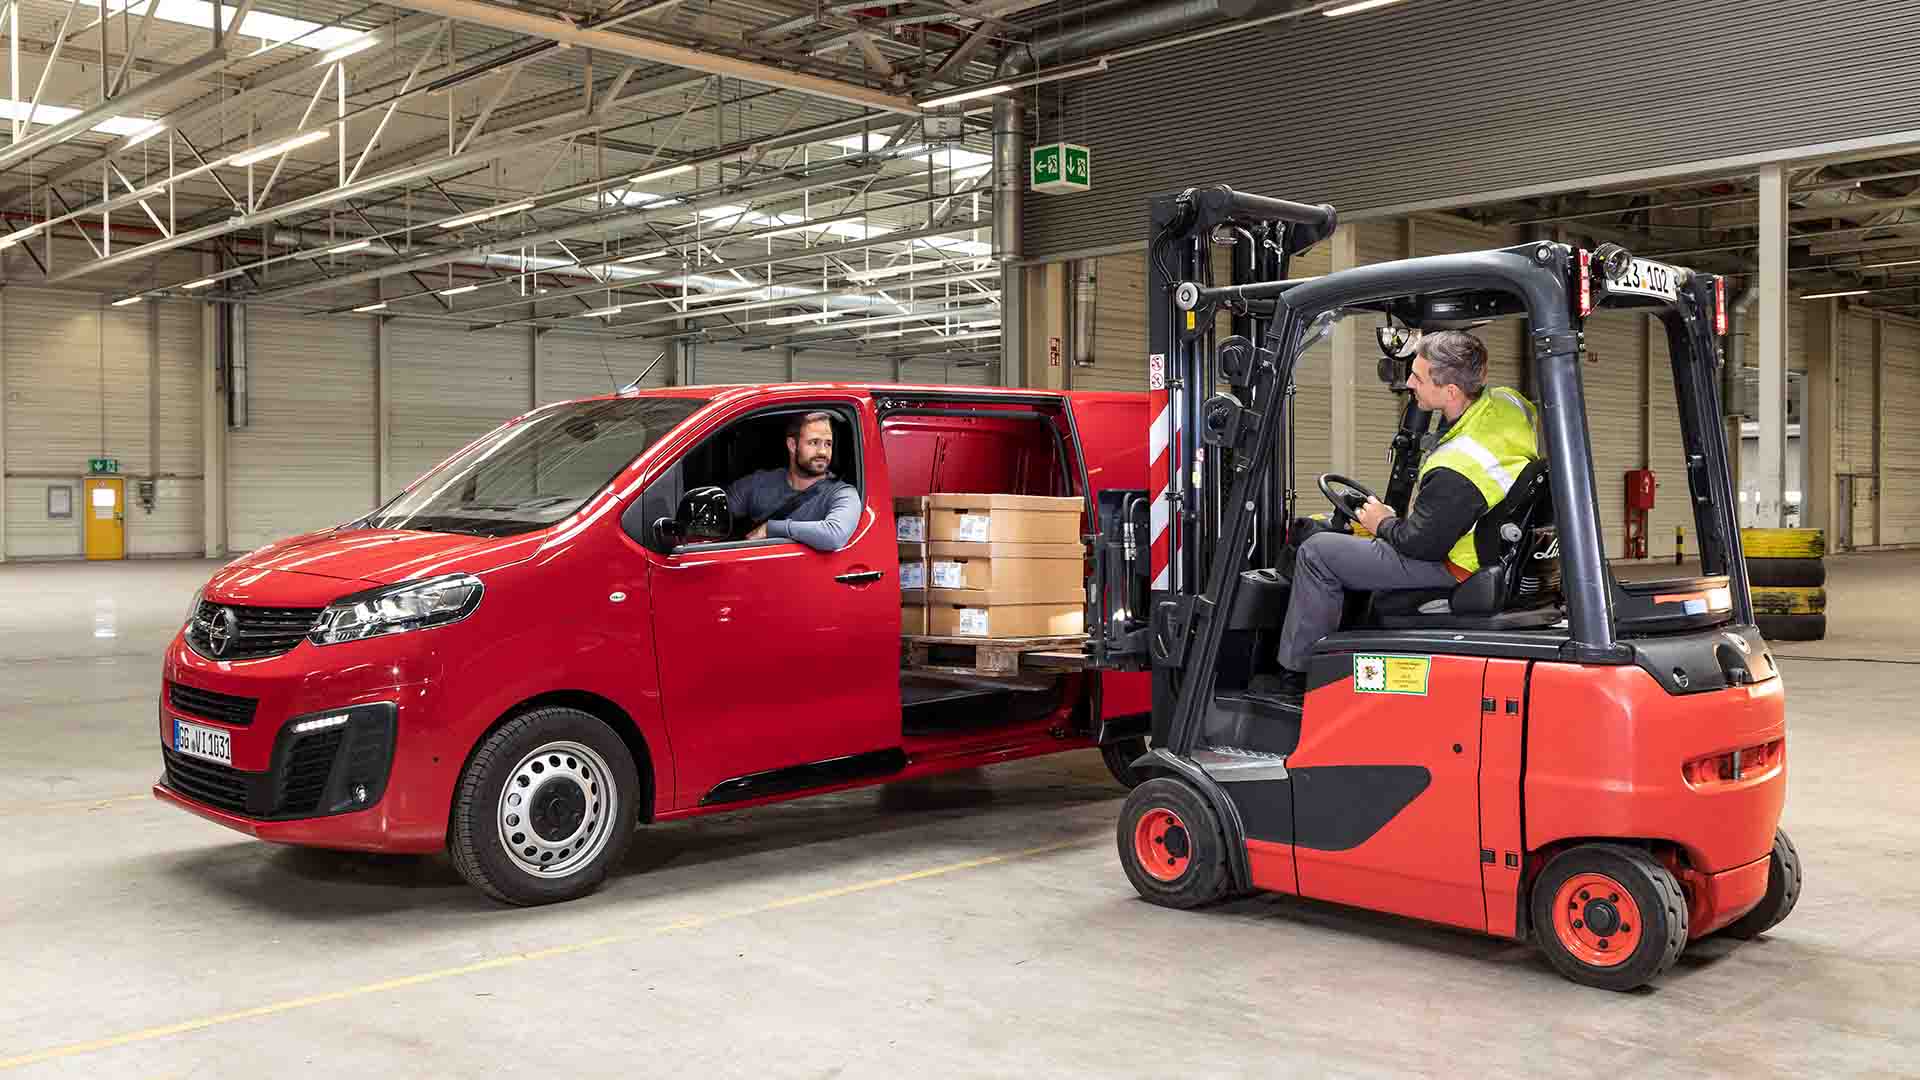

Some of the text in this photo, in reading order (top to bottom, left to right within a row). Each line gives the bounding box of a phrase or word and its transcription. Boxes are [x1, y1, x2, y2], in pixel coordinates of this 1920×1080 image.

[1614, 263, 1669, 294] 13 102
[208, 733, 231, 760] 1031
